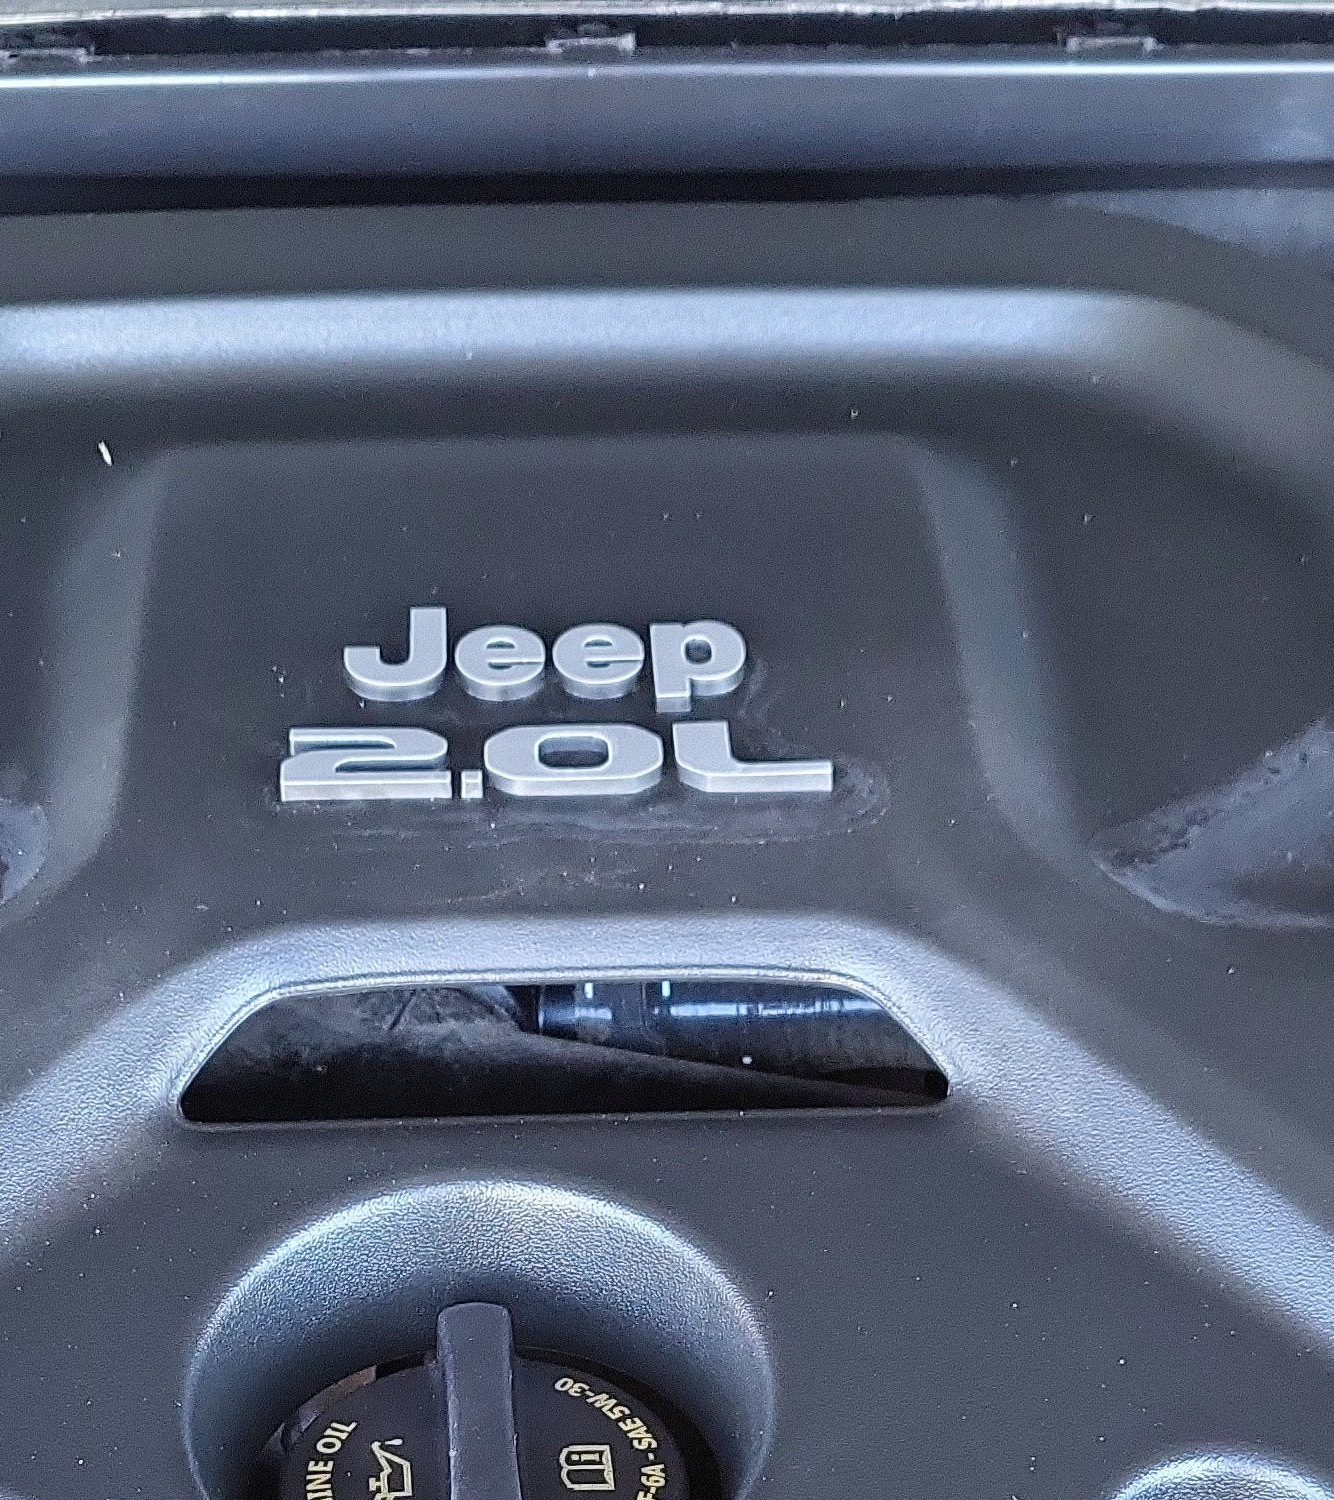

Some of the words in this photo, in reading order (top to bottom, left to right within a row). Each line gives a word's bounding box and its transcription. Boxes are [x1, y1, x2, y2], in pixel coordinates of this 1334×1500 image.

[343, 605, 747, 712] Jeep
[280, 720, 834, 802] 2.0L
[554, 1377, 631, 1421] 5W-30
[315, 1421, 358, 1454] OIL
[617, 1416, 658, 1451] SAE
